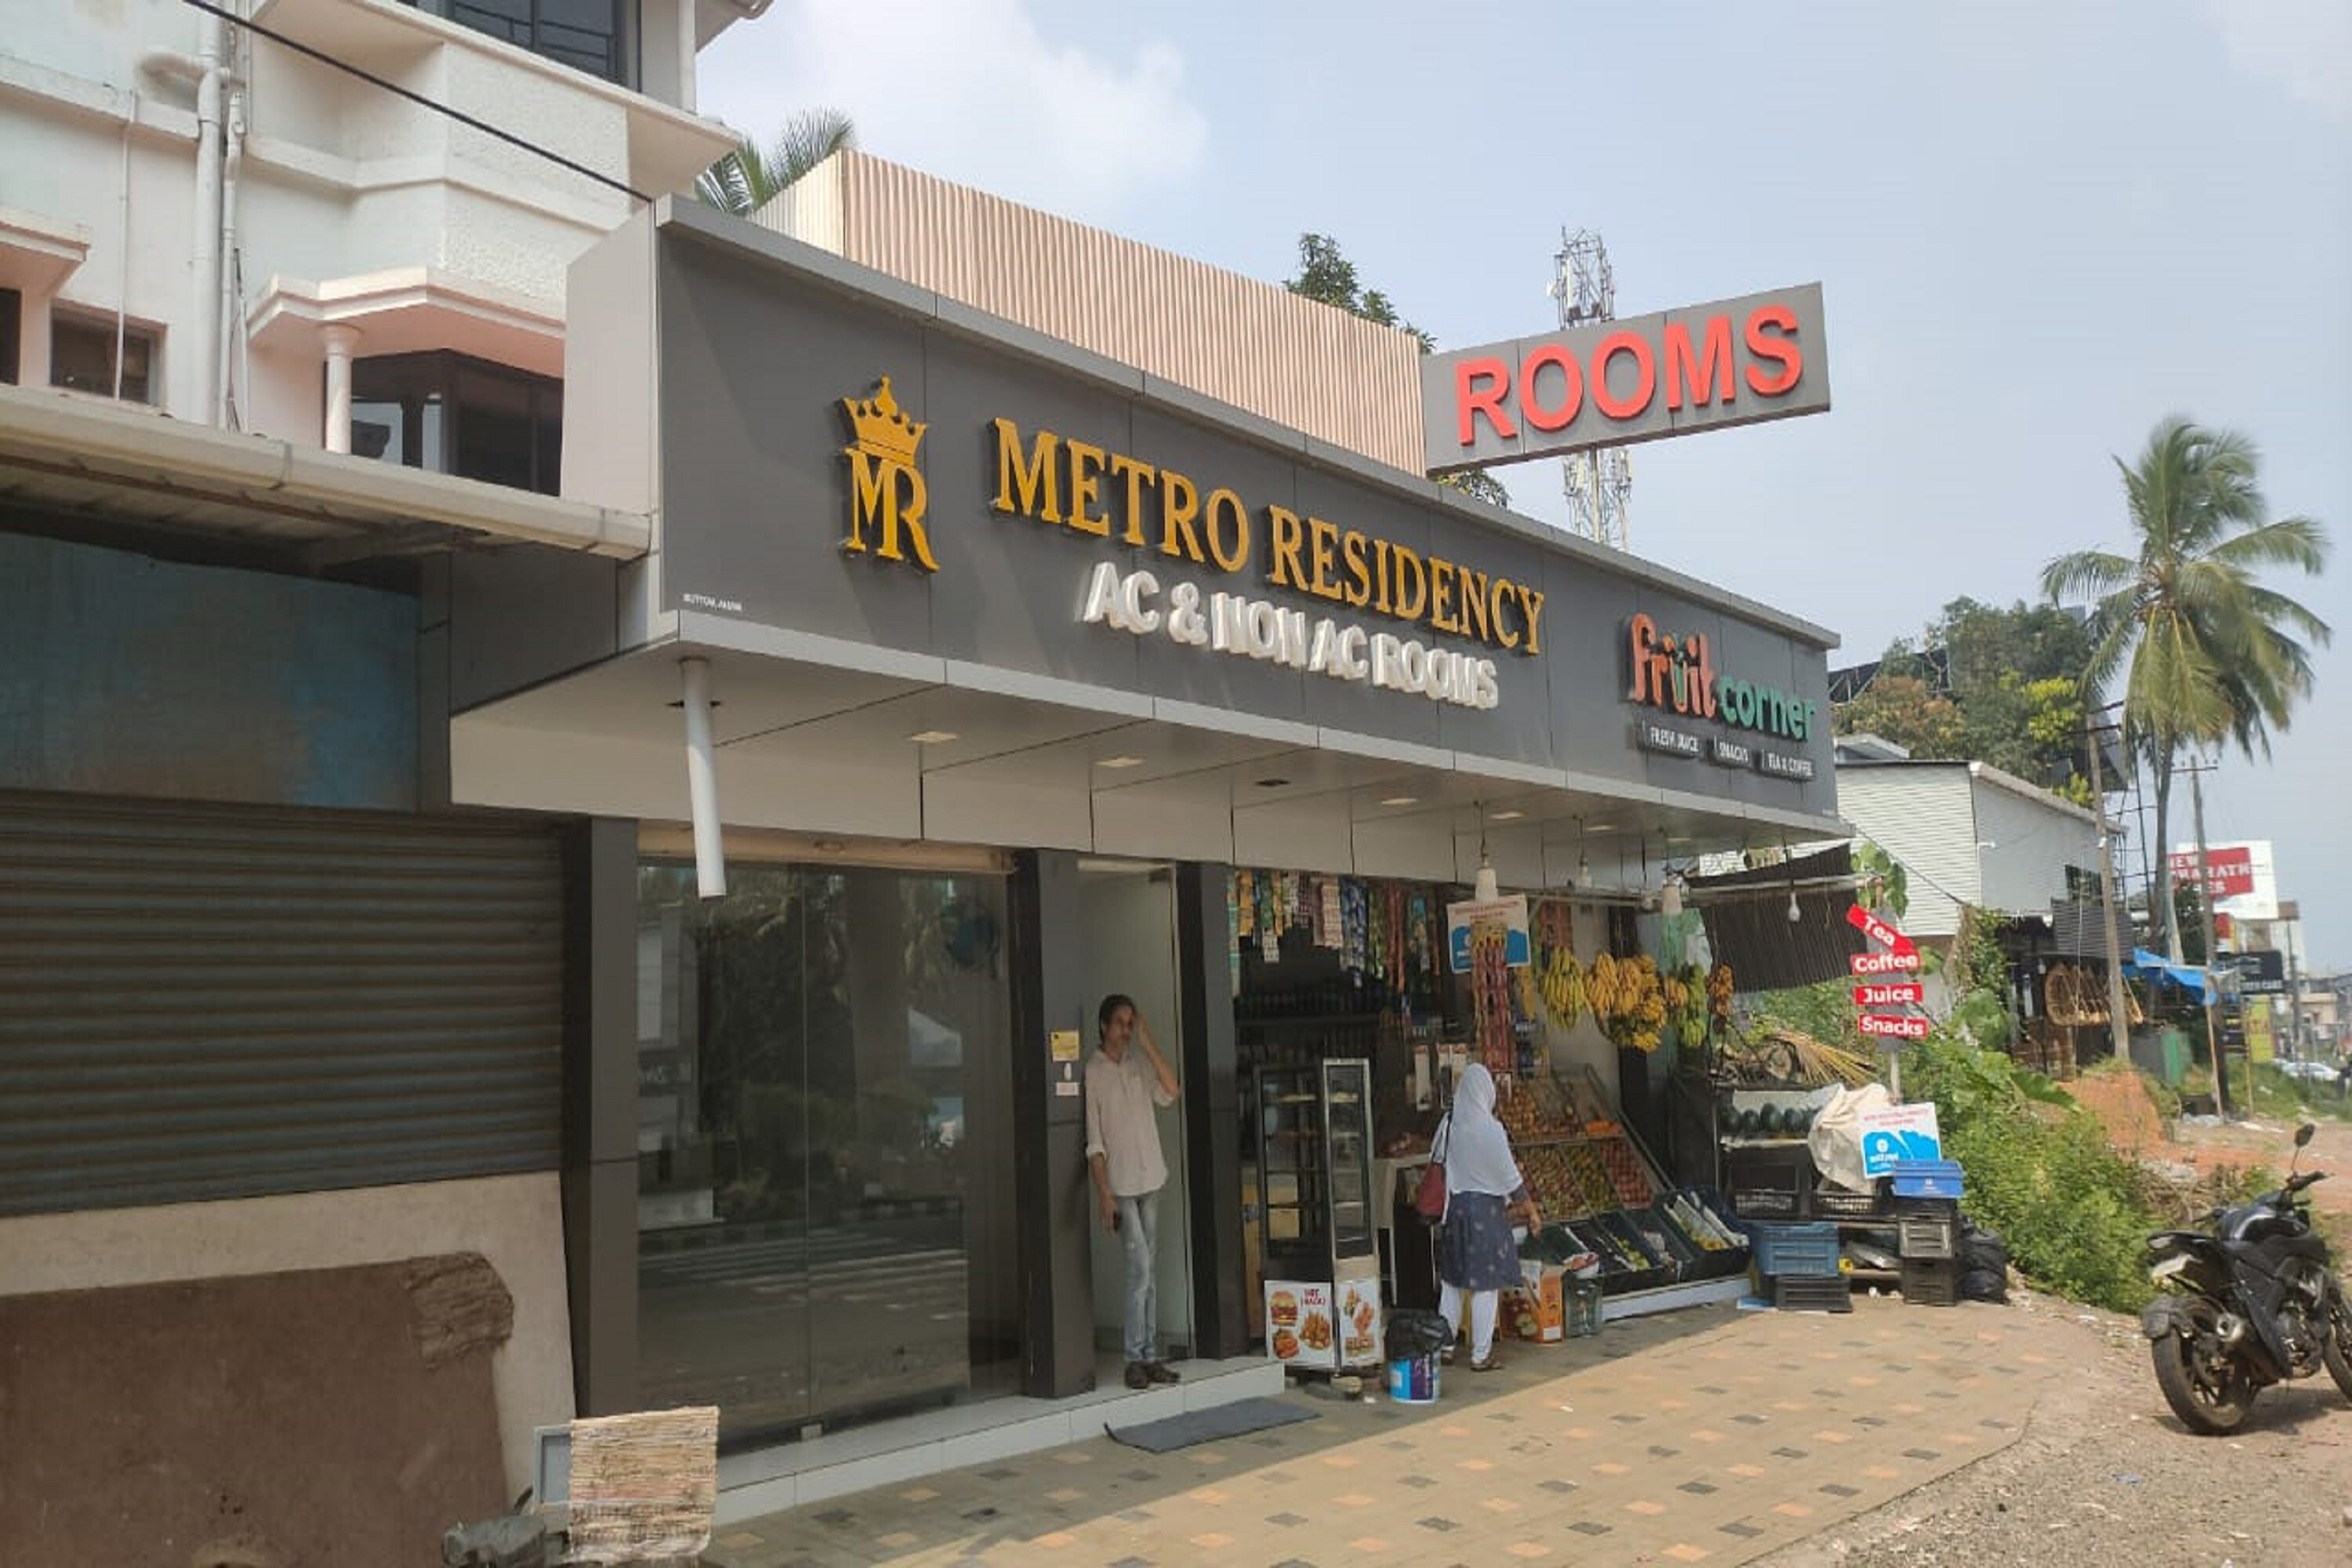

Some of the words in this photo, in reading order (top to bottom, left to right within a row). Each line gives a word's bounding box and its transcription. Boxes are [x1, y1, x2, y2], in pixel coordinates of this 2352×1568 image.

[1455, 303, 1803, 446] ROOMS
[843, 446, 941, 573] MR
[991, 416, 1250, 573] METRO
[1266, 503, 1545, 655] RESIDENCY
[1083, 561, 1160, 633] AC
[1168, 581, 1208, 646] &
[1211, 590, 1307, 667] NON
[1308, 618, 1369, 681] AC
[1370, 631, 1499, 710] ROOMS
[1626, 612, 1716, 718] fruit
[1717, 672, 1817, 741] corner
[1854, 953, 1918, 973] Coffee
[1864, 913, 1896, 946] Tea
[1861, 1015, 1925, 1036] Snacks
[1863, 986, 1915, 1004] Juice
